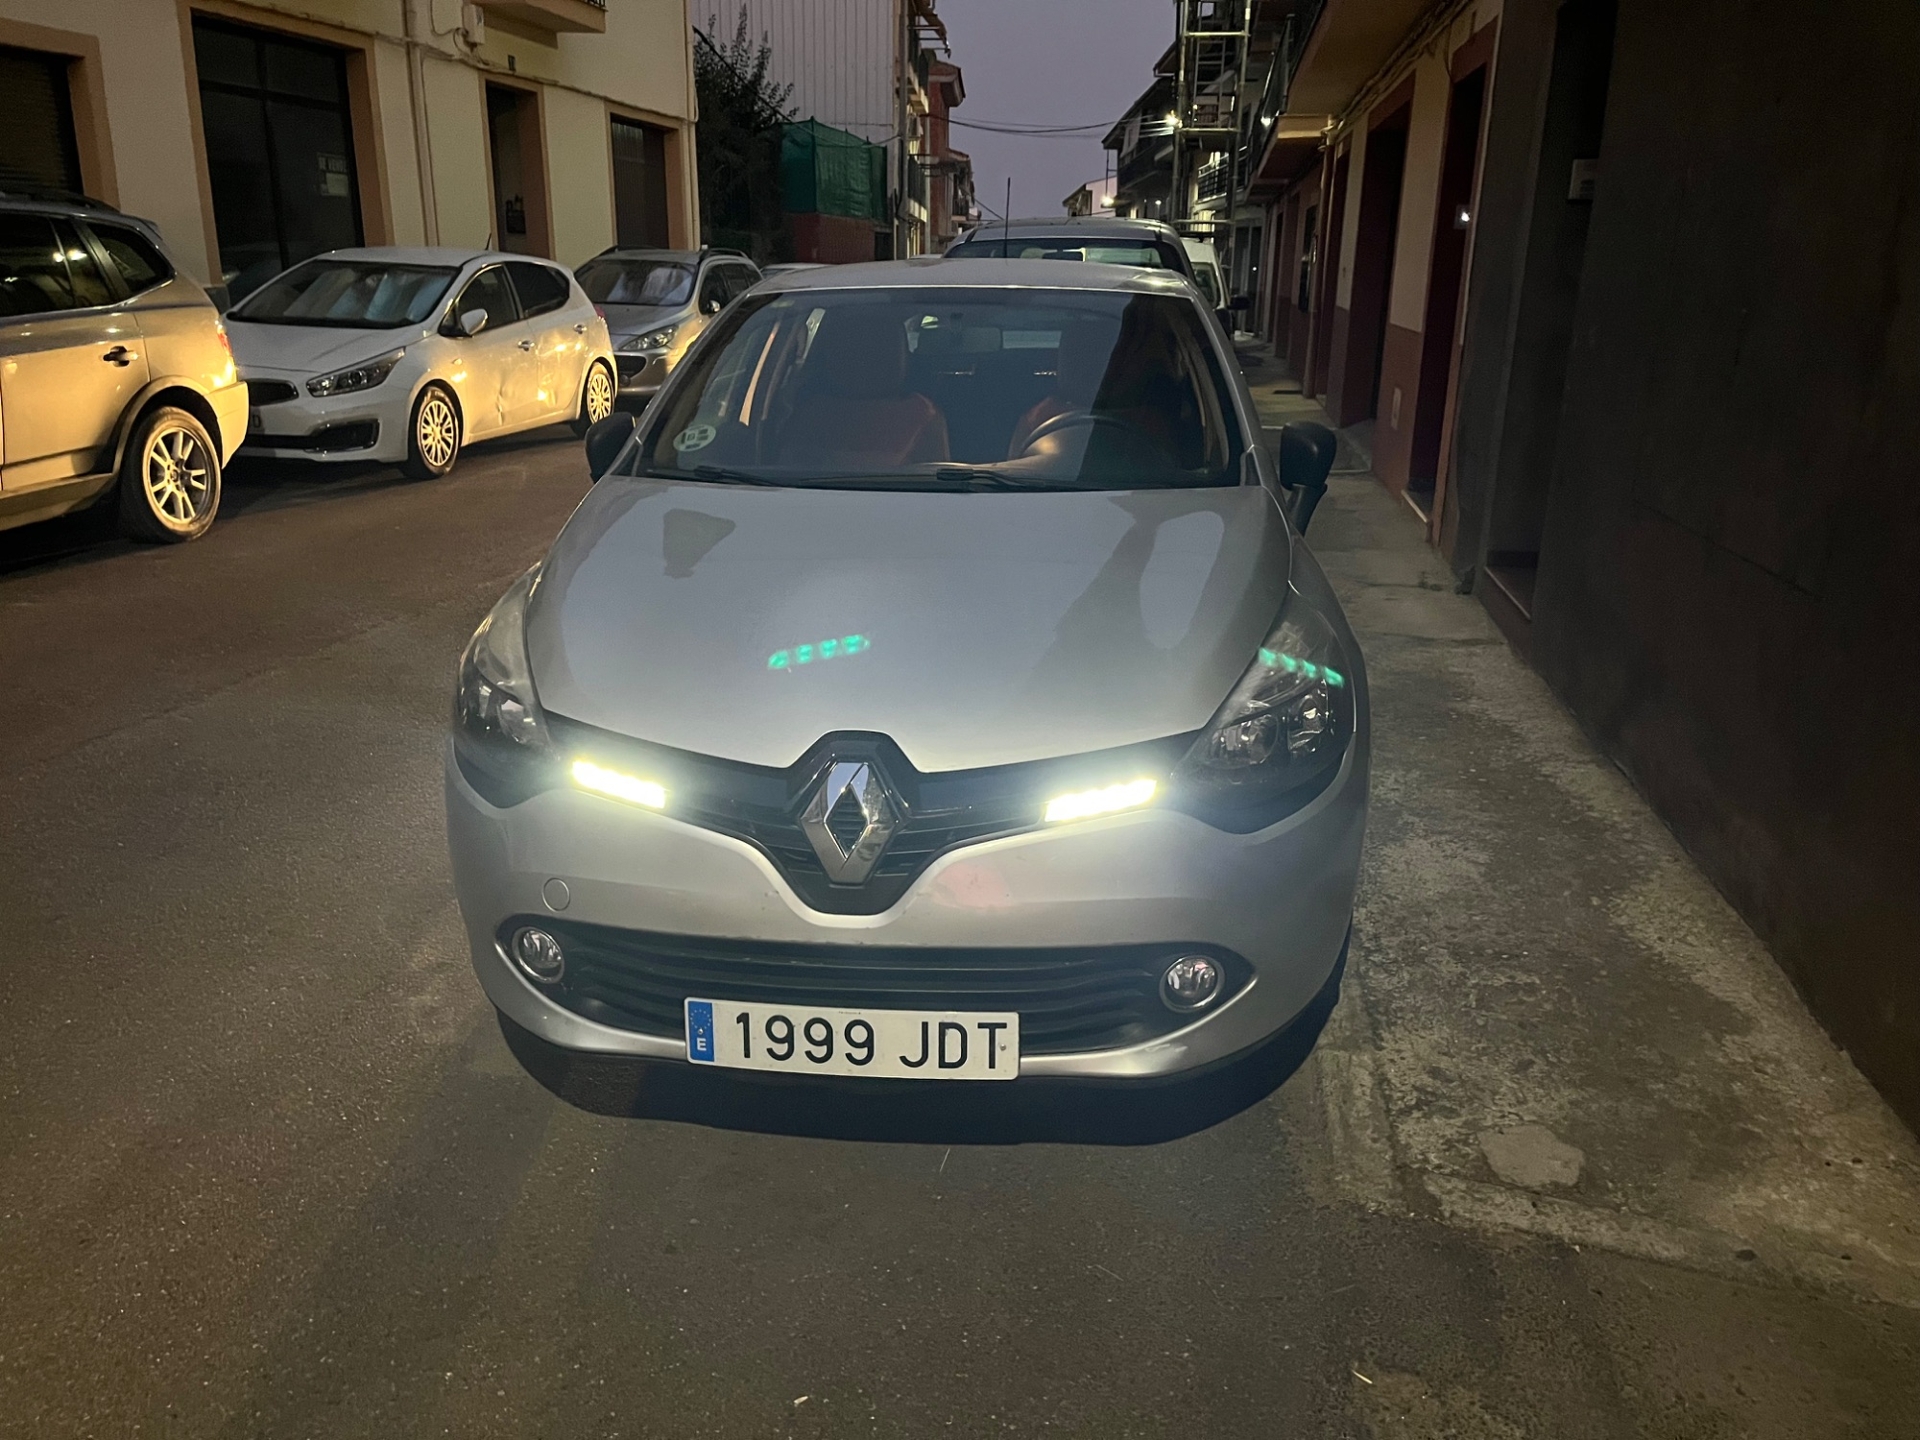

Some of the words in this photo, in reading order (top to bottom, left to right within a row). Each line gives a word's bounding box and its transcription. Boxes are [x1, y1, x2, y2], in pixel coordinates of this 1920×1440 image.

[696, 1038, 707, 1051] E
[735, 1012, 875, 1066] 1999
[899, 1021, 1008, 1069] JDT
